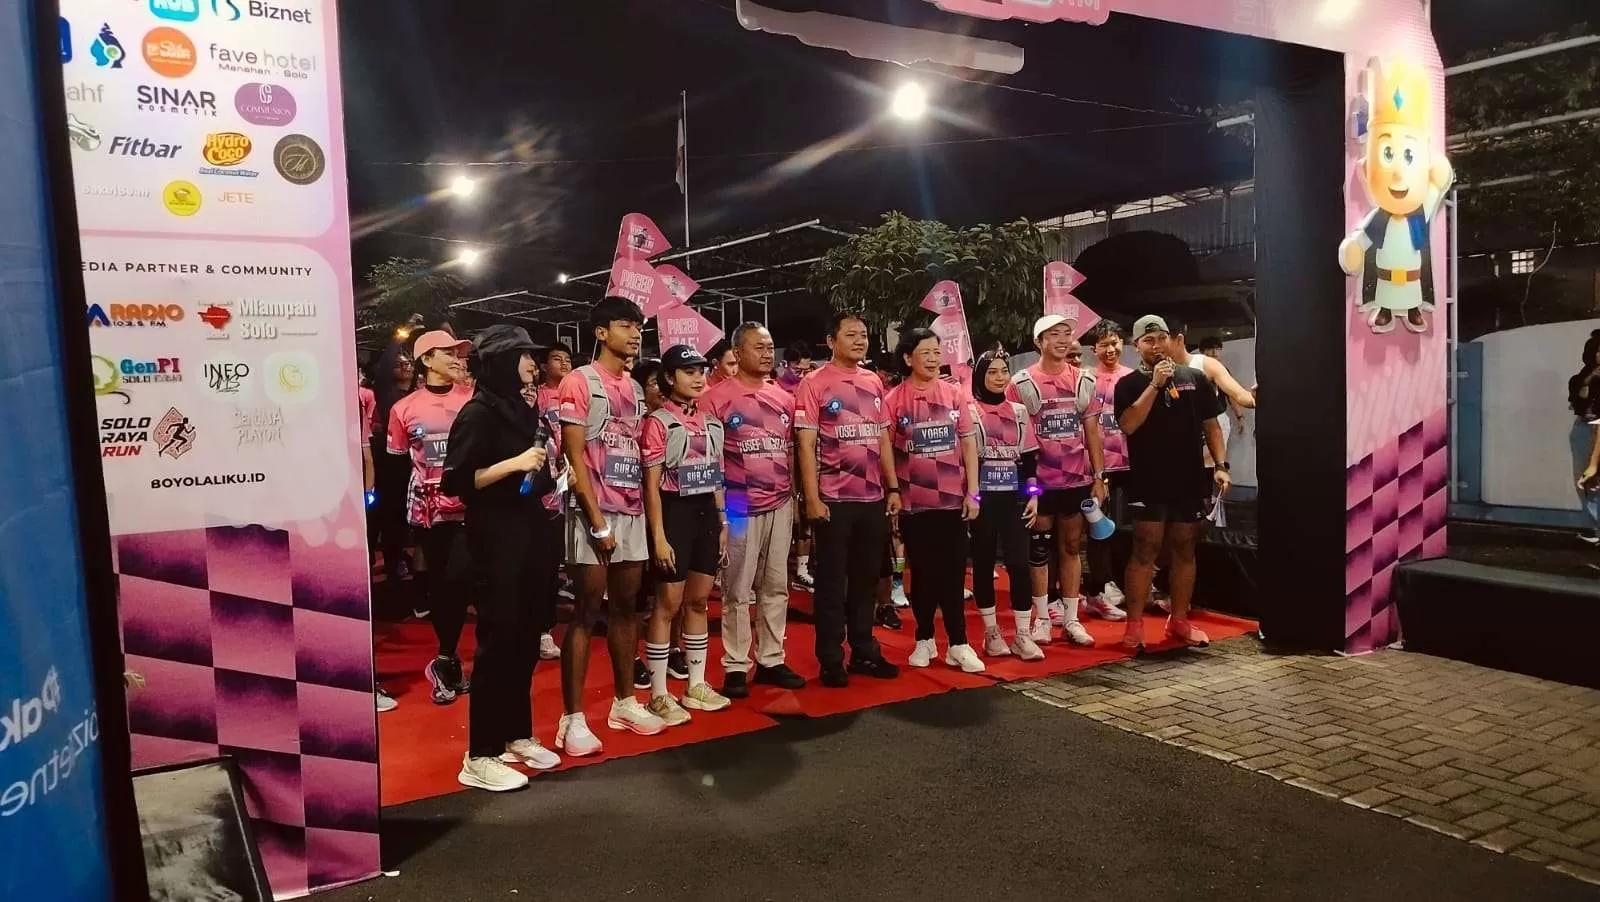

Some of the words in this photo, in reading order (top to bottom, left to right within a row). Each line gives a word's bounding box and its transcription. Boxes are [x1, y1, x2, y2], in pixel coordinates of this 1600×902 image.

[248, 1, 312, 24] Biznet
[209, 43, 258, 64] fave
[264, 50, 317, 72] hotel
[136, 85, 217, 110] SINAR
[108, 136, 182, 159] Fitbar
[206, 133, 250, 148] Hydro
[206, 148, 246, 165] Coco
[217, 191, 256, 204] JETE
[81, 261, 118, 272] EDIA
[125, 262, 199, 275] PARTNER
[205, 264, 216, 274] &
[221, 264, 313, 277] COMMUNITY
[110, 303, 185, 322] RADIO
[240, 323, 279, 340] Solo
[120, 357, 180, 375] GenPI
[203, 363, 250, 378] INFO
[122, 375, 151, 384] SOLO
[101, 417, 151, 430] SOLO
[101, 431, 149, 443] RAYA
[102, 445, 142, 458] RUN
[151, 472, 266, 489] BOYOLALIKU.ID
